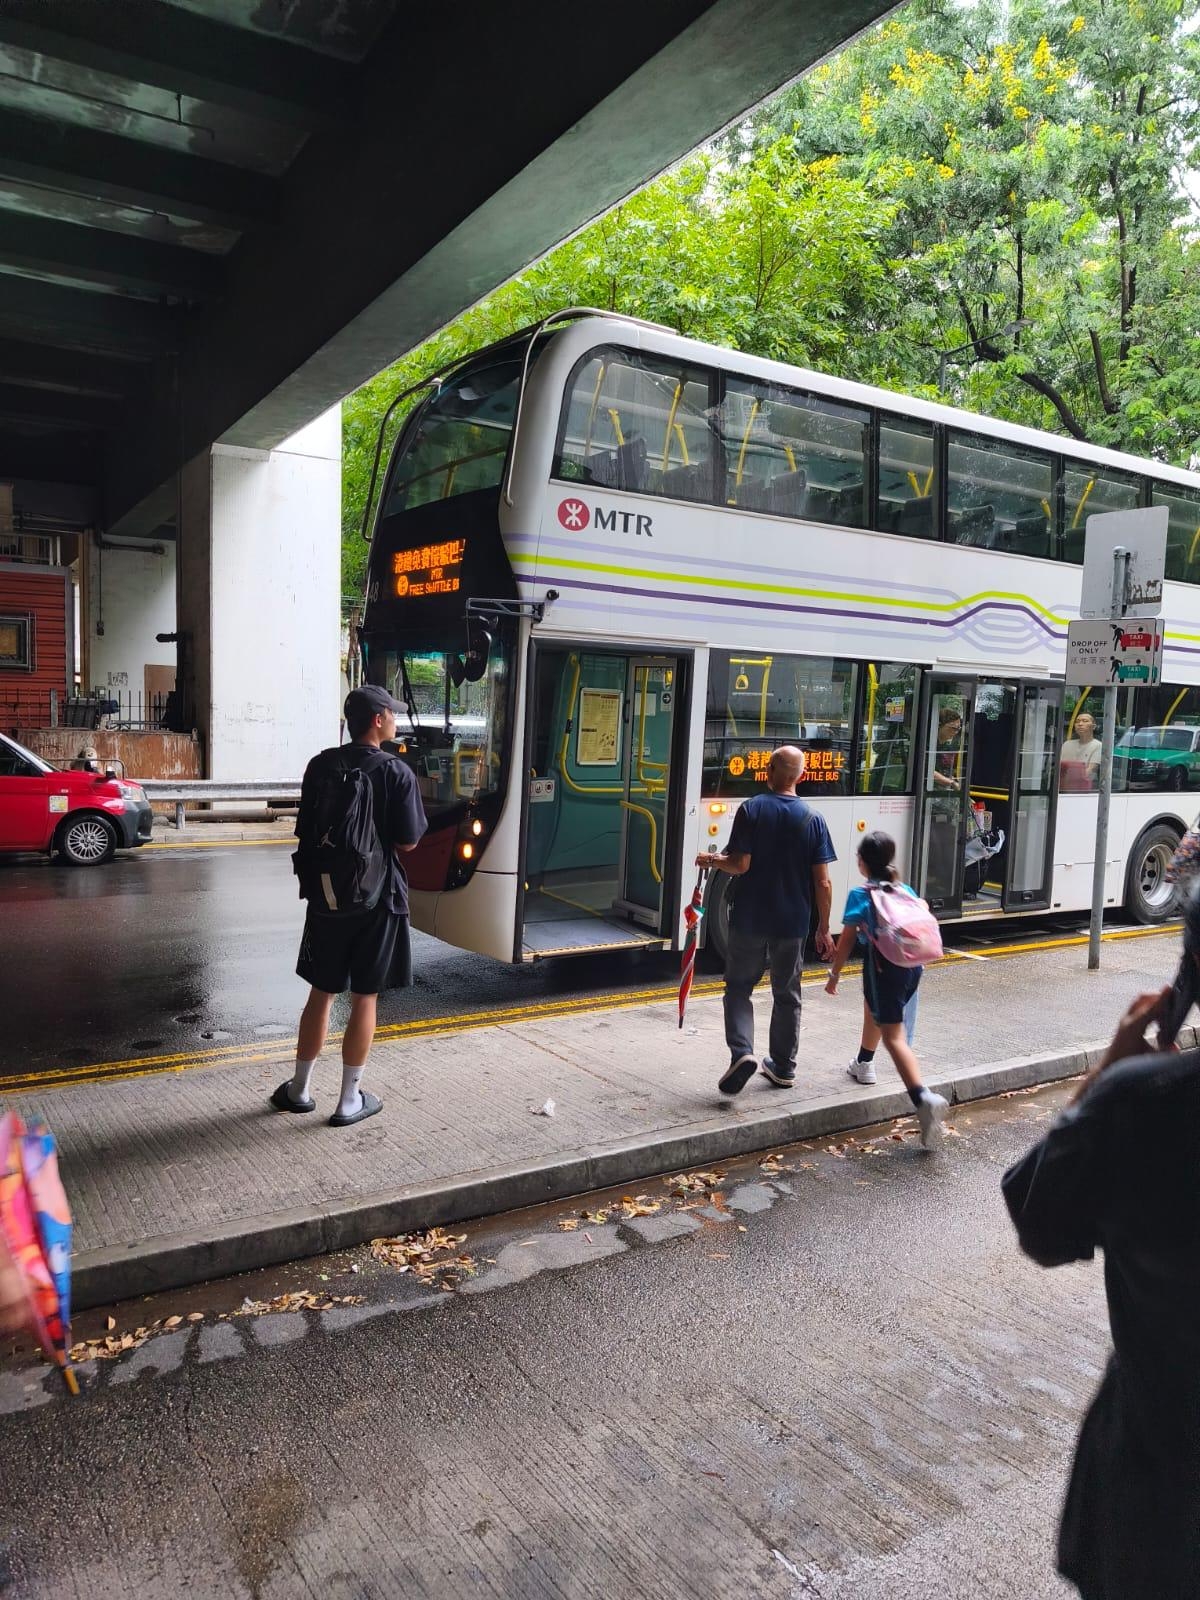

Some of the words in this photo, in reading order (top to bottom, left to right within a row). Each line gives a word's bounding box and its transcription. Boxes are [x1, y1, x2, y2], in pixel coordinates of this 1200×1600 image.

[594, 507, 653, 537] MTR
[409, 583, 425, 596] FREE
[425, 579, 452, 594] SHUTTLE
[825, 771, 839, 781] BUS
